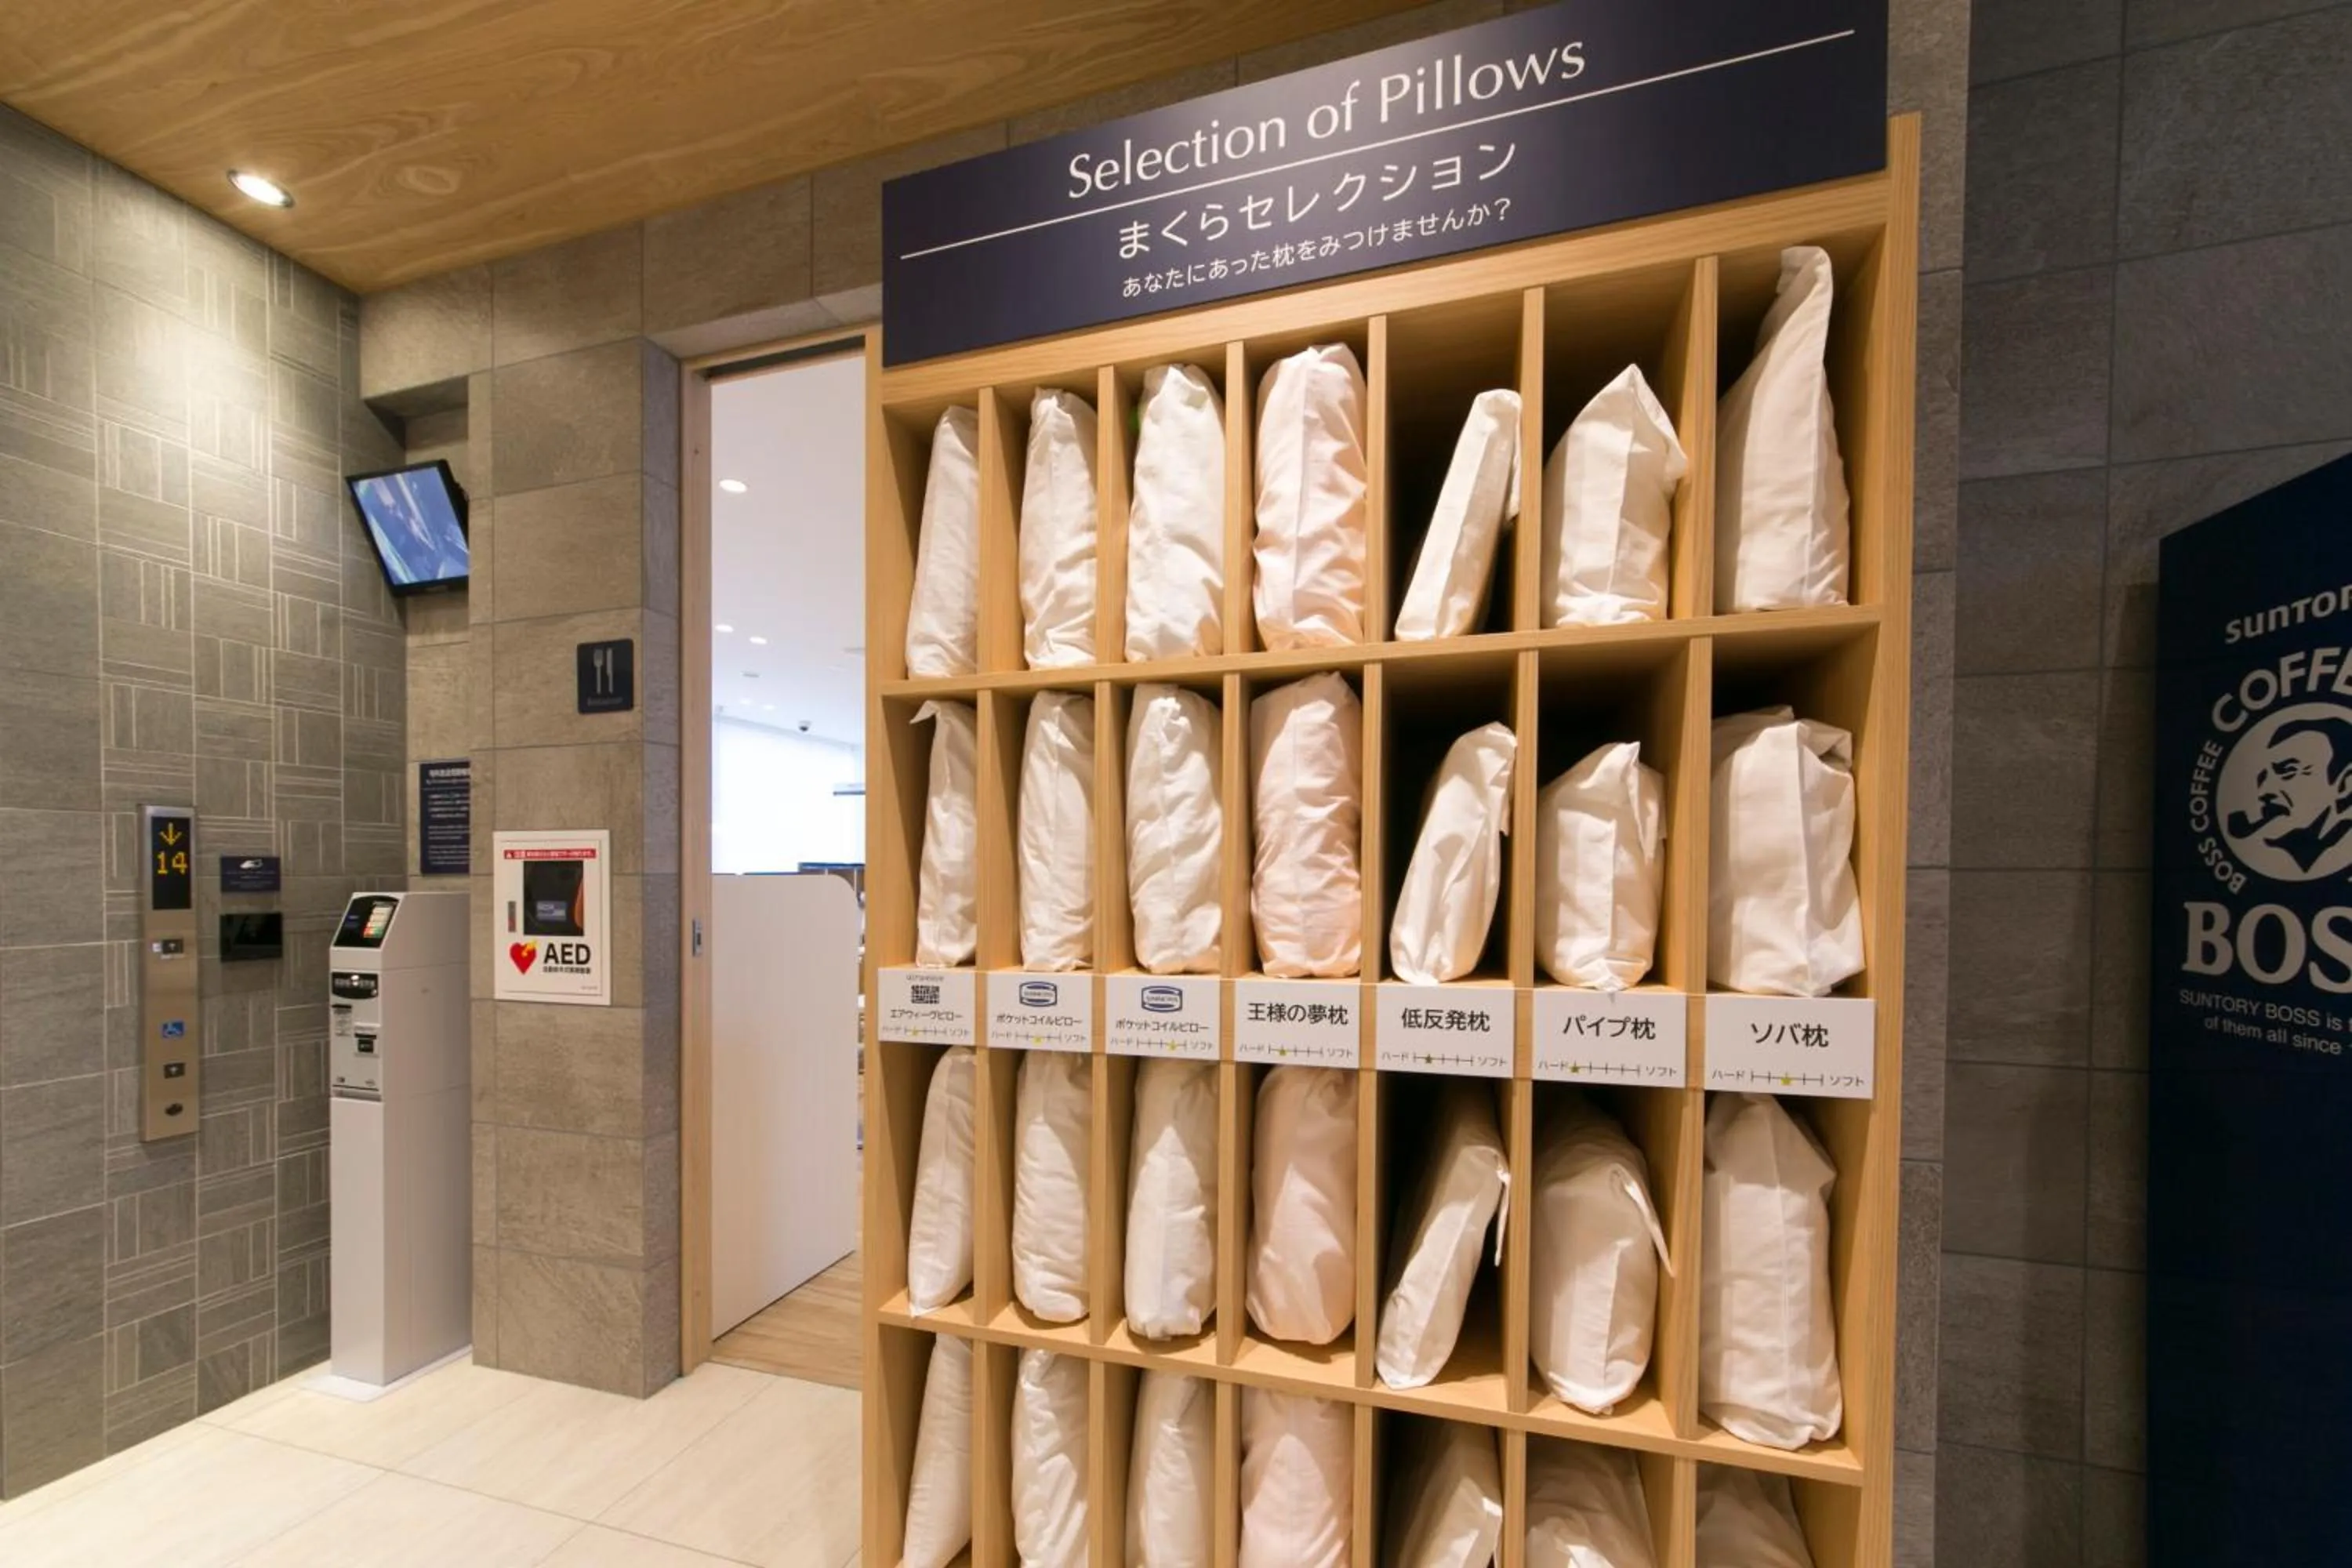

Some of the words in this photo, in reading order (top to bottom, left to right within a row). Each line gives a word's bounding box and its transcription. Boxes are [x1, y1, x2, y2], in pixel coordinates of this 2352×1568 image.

[1069, 117, 1286, 198] Selection
[1306, 80, 1360, 139] of
[1380, 42, 1584, 123] Pillows
[1119, 143, 1515, 258] まくらセレクション
[2189, 739, 2223, 833] COFFEE
[157, 851, 187, 875] 14
[2198, 837, 2247, 895] BOSS
[543, 942, 591, 965] AED
[1247, 1002, 1348, 1025] 王様の夢枕
[1401, 1007, 1490, 1033] 低反発枕
[2180, 989, 2260, 1017] SUNTORY
[2265, 1003, 2321, 1027] BOSS
[2326, 1013, 2343, 1031] is
[1563, 1016, 1656, 1040] パイプ枕
[1751, 1022, 1829, 1048] ソバ枕
[2205, 1015, 2218, 1029] of
[2223, 1018, 2263, 1039] them
[2266, 1029, 2287, 1044] all
[2292, 1033, 2342, 1055] since
[1711, 1069, 1745, 1080] ハード
[1829, 1075, 1865, 1087] ソフト
